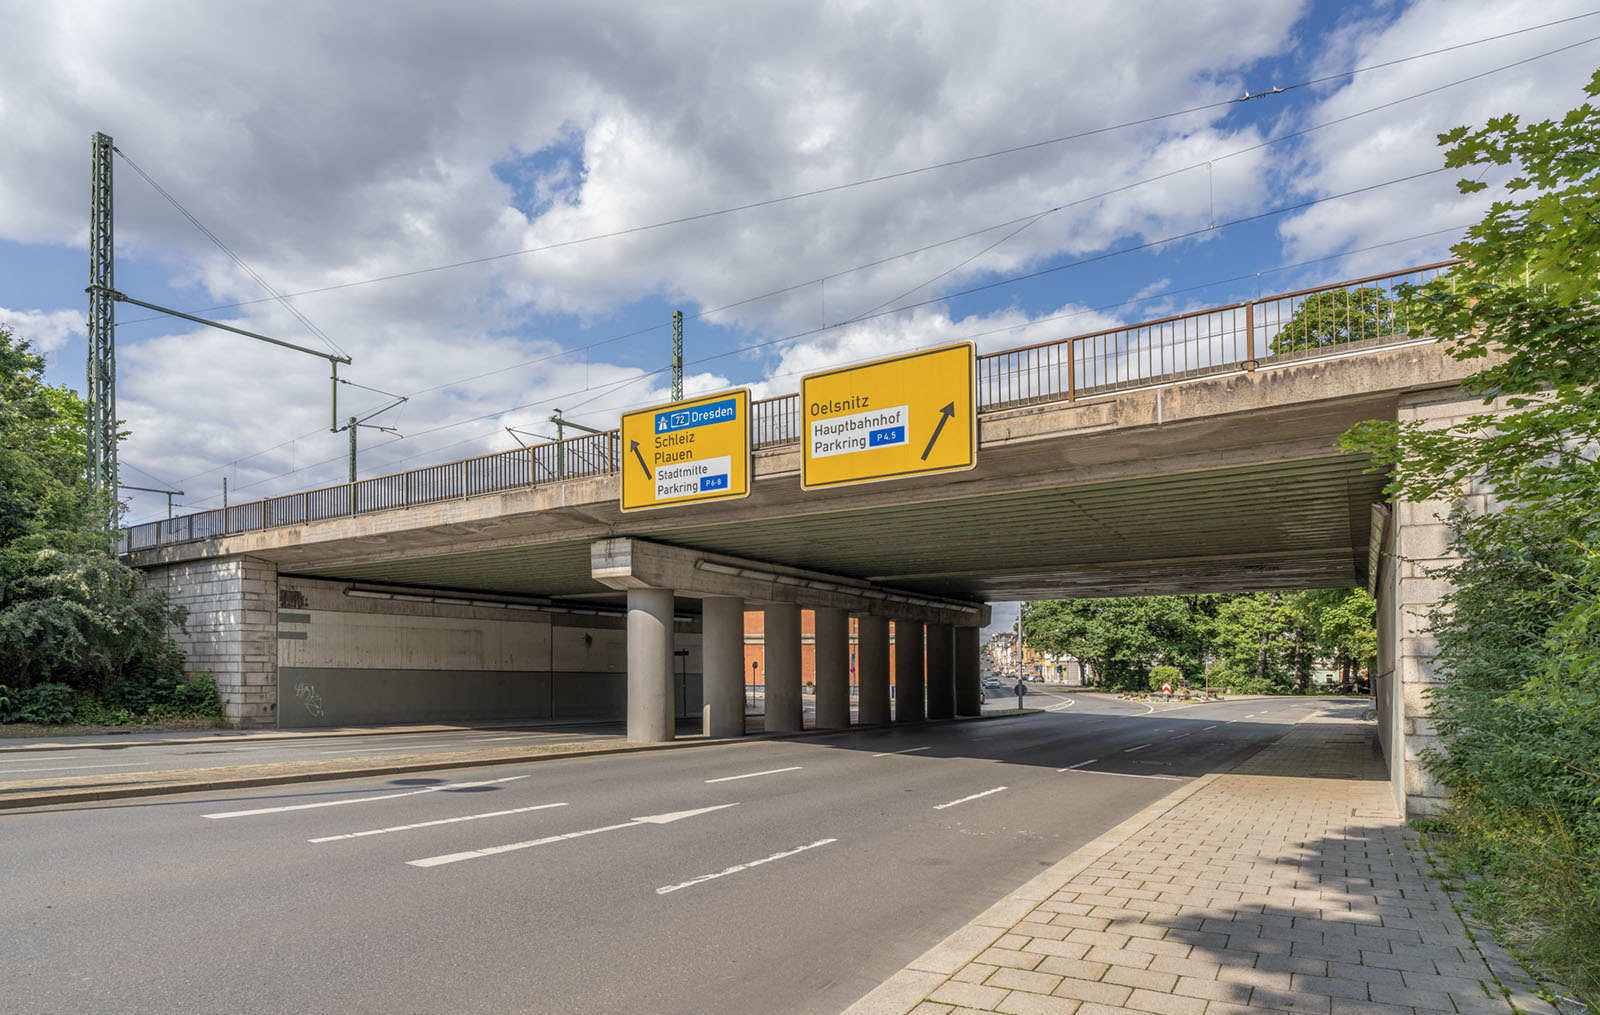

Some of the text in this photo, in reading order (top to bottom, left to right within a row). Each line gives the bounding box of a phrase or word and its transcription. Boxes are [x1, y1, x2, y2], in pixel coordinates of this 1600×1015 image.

[811, 396, 869, 416] Oelsnitz
[675, 407, 733, 425] 72 Dresden
[814, 411, 901, 436] Hauptbahnhof
[655, 431, 695, 448] Schleiz
[815, 436, 866, 453] Parkring
[655, 449, 693, 464] Plauen
[658, 465, 708, 481] Stadtmitte
[658, 482, 698, 496] Parkring
